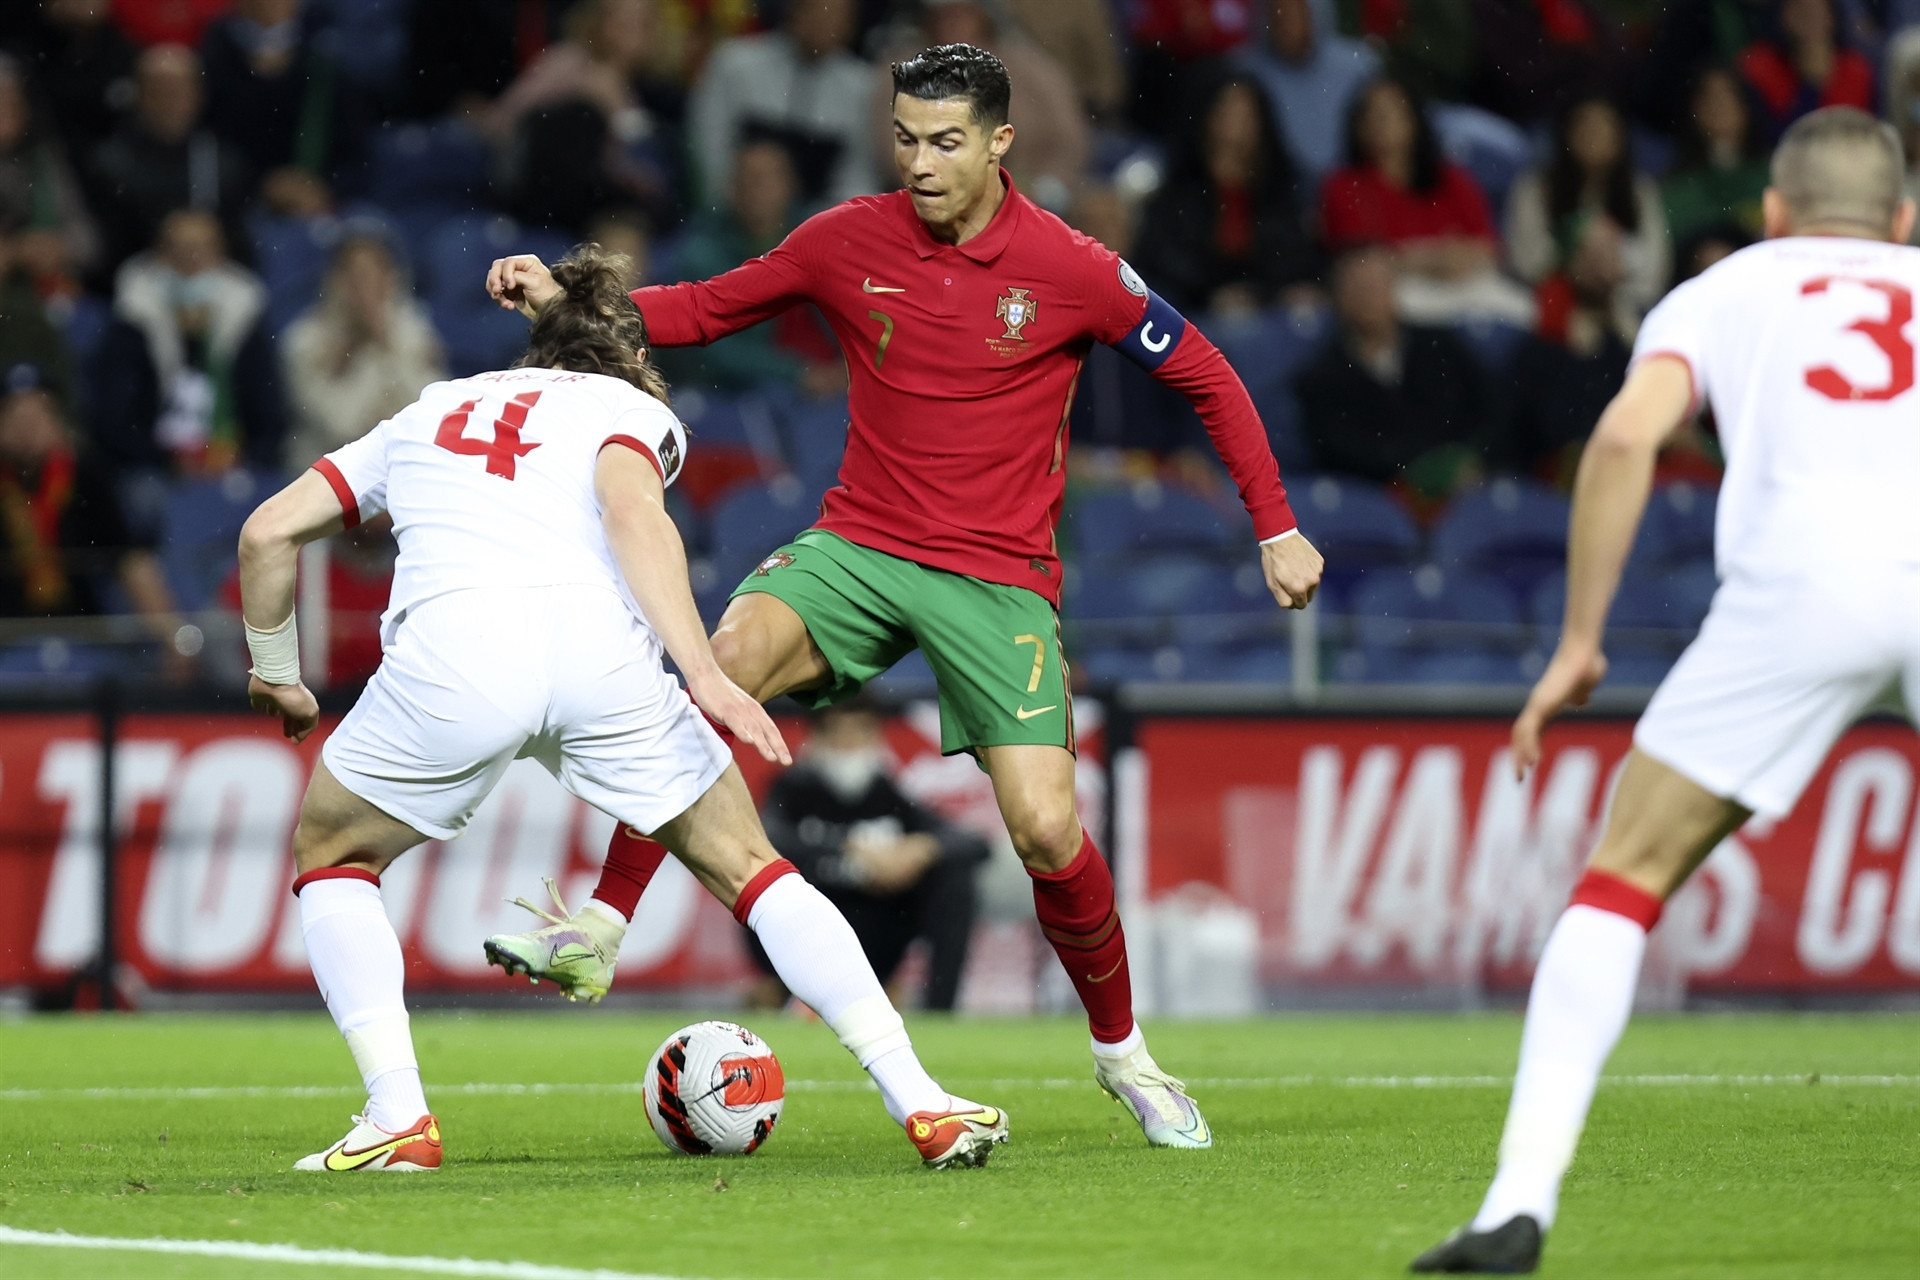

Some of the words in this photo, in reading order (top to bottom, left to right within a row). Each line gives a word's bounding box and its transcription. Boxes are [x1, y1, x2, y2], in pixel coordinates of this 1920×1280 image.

[868, 310, 893, 371] 7
[1140, 320, 1171, 353] C
[1800, 274, 1915, 401] 3
[433, 389, 544, 481] 4
[1014, 633, 1045, 692] 7
